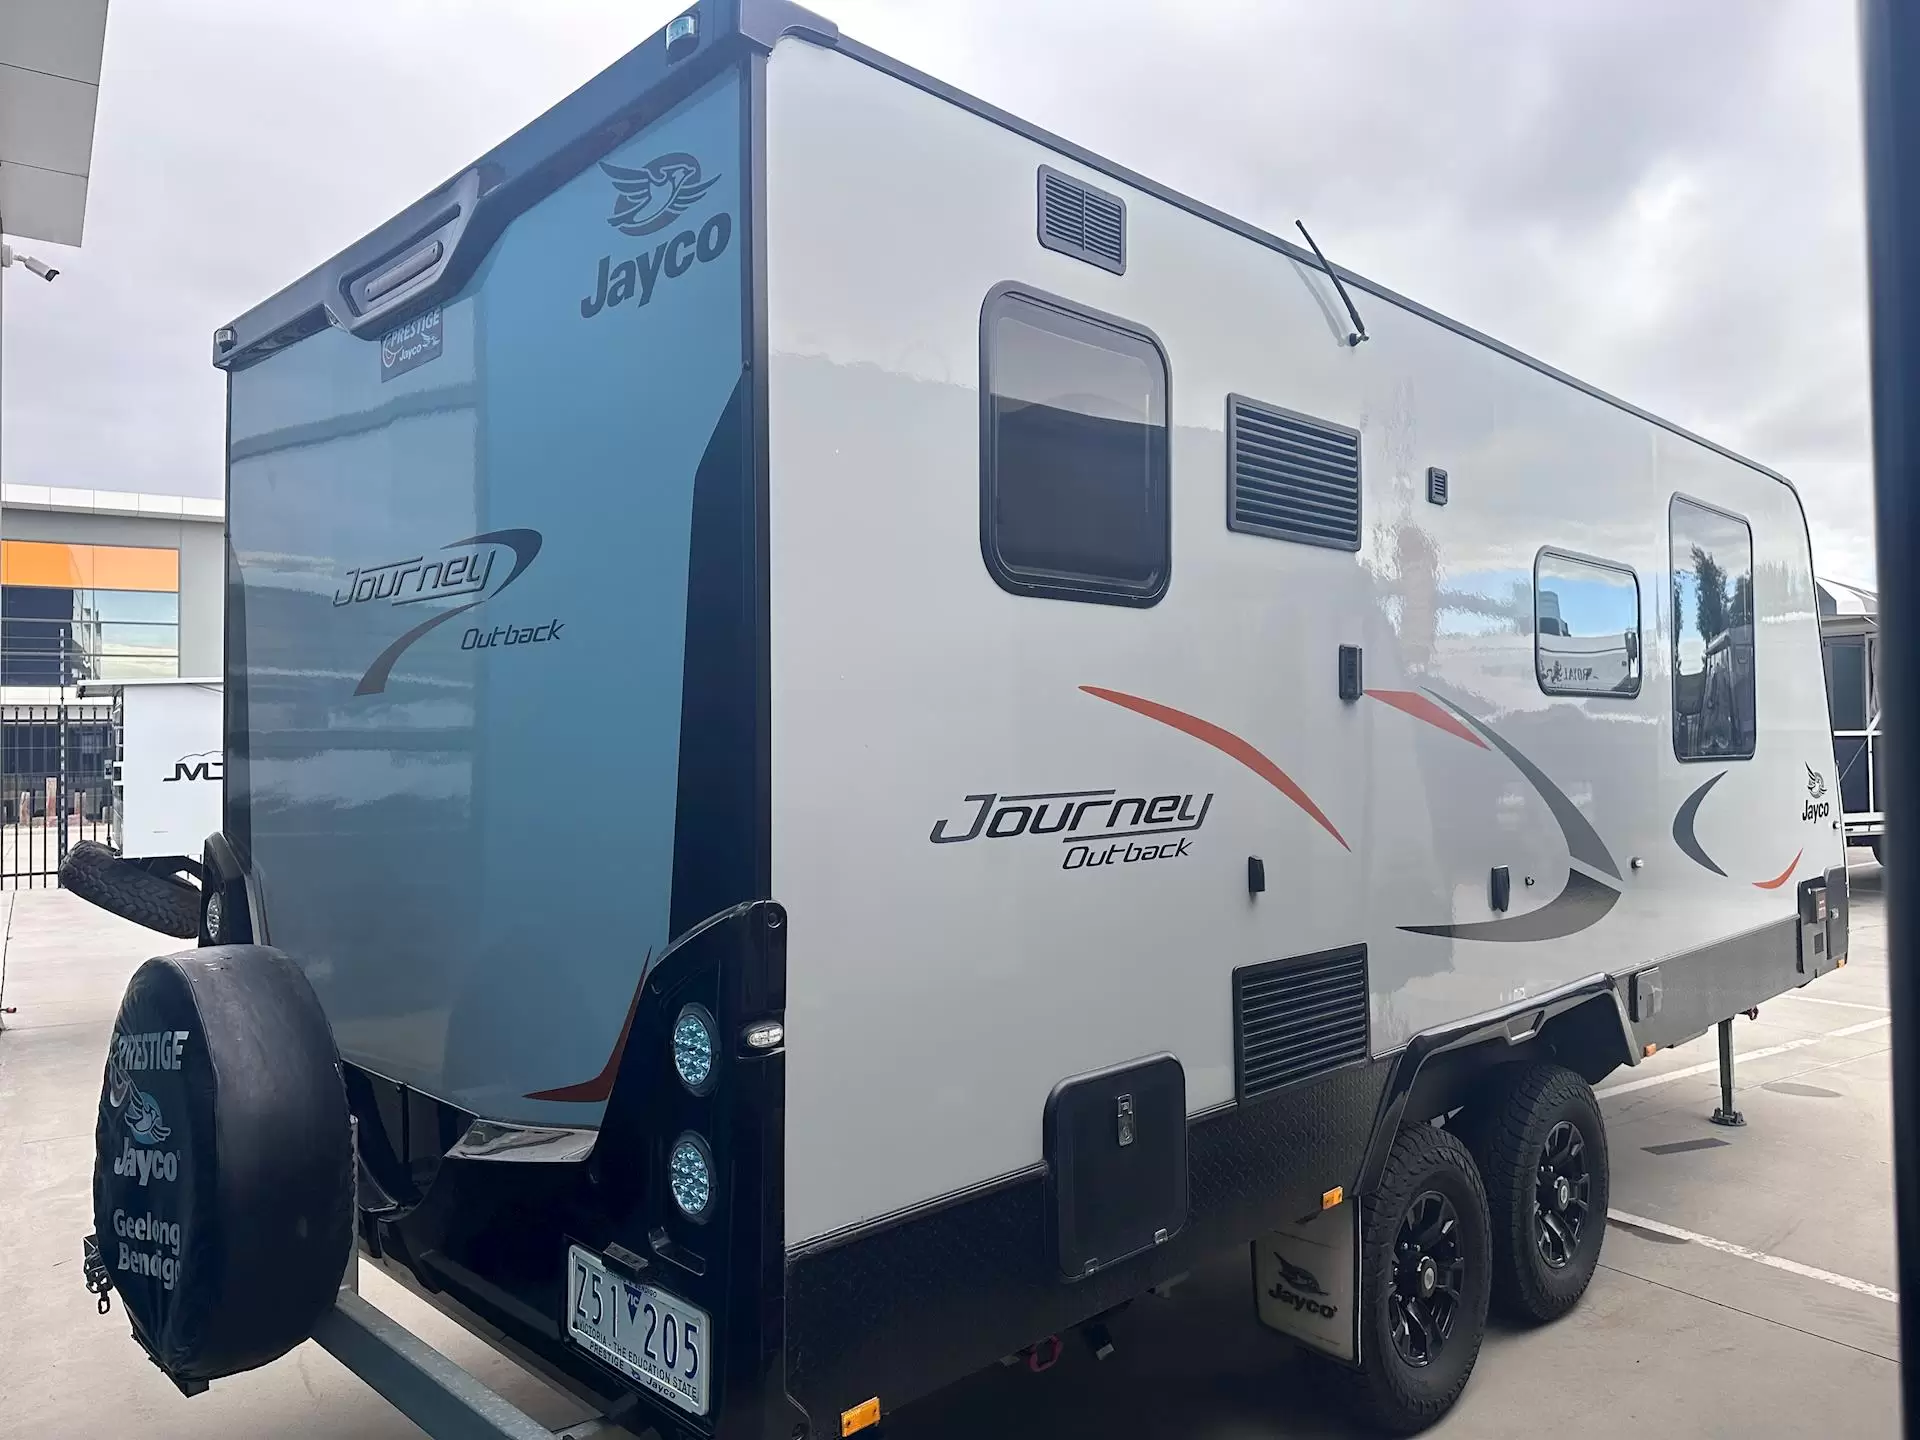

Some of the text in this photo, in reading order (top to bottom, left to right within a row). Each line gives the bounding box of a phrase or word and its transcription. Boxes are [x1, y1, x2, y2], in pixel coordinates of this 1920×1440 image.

[581, 212, 731, 318] Jayco
[390, 307, 440, 347] PRESTIGE
[400, 344, 421, 361] Jayco
[333, 549, 496, 607] Journey
[461, 619, 565, 650] Outback
[929, 789, 1213, 843] Journey
[1802, 800, 1829, 824] Jayco
[1062, 838, 1192, 870] Outback
[118, 1031, 190, 1071] PRESTIGE
[114, 1137, 179, 1186] Jayco
[113, 1208, 181, 1256] Geelong
[1268, 1283, 1336, 1319] Jayco
[579, 1321, 607, 1347] VICTORIA
[614, 1341, 626, 1358] THE
[628, 1350, 671, 1385] EDUCATION
[673, 1375, 697, 1400] STATE
[644, 1303, 700, 1379] 205
[590, 1341, 676, 1399] PRESTIGE Jayco
